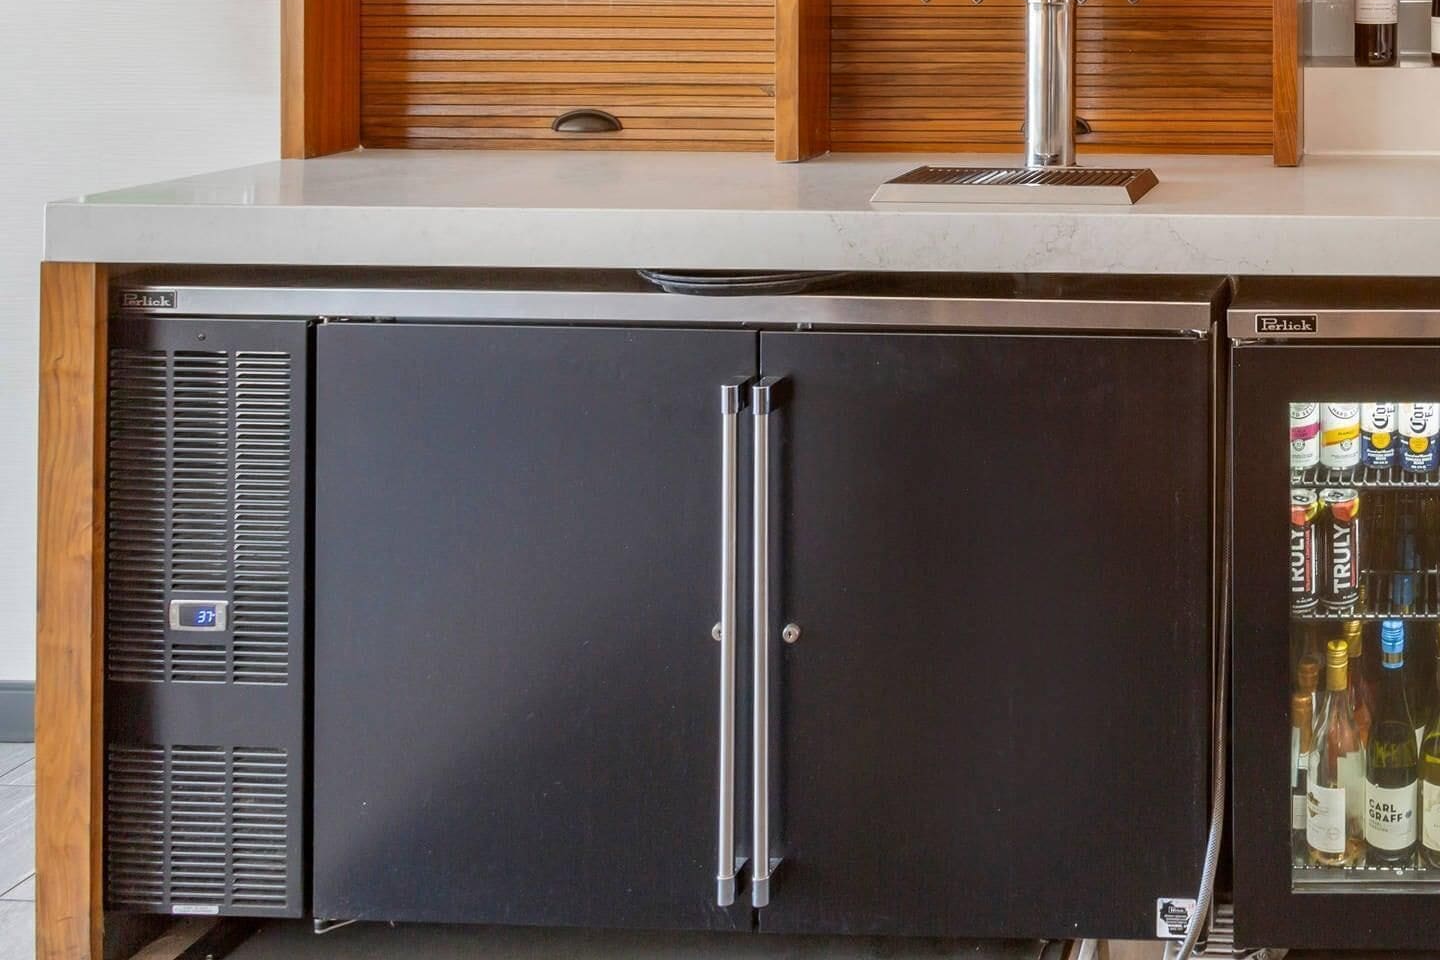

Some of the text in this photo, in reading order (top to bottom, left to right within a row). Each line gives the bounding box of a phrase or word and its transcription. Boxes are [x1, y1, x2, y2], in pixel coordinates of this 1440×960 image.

[123, 293, 172, 307] Perlick
[1261, 317, 1313, 332] Perlick
[1333, 523, 1351, 594] TRULY
[197, 610, 213, 624] 37
[1368, 798, 1397, 813] CARL
[1368, 809, 1404, 823] GRAFF
